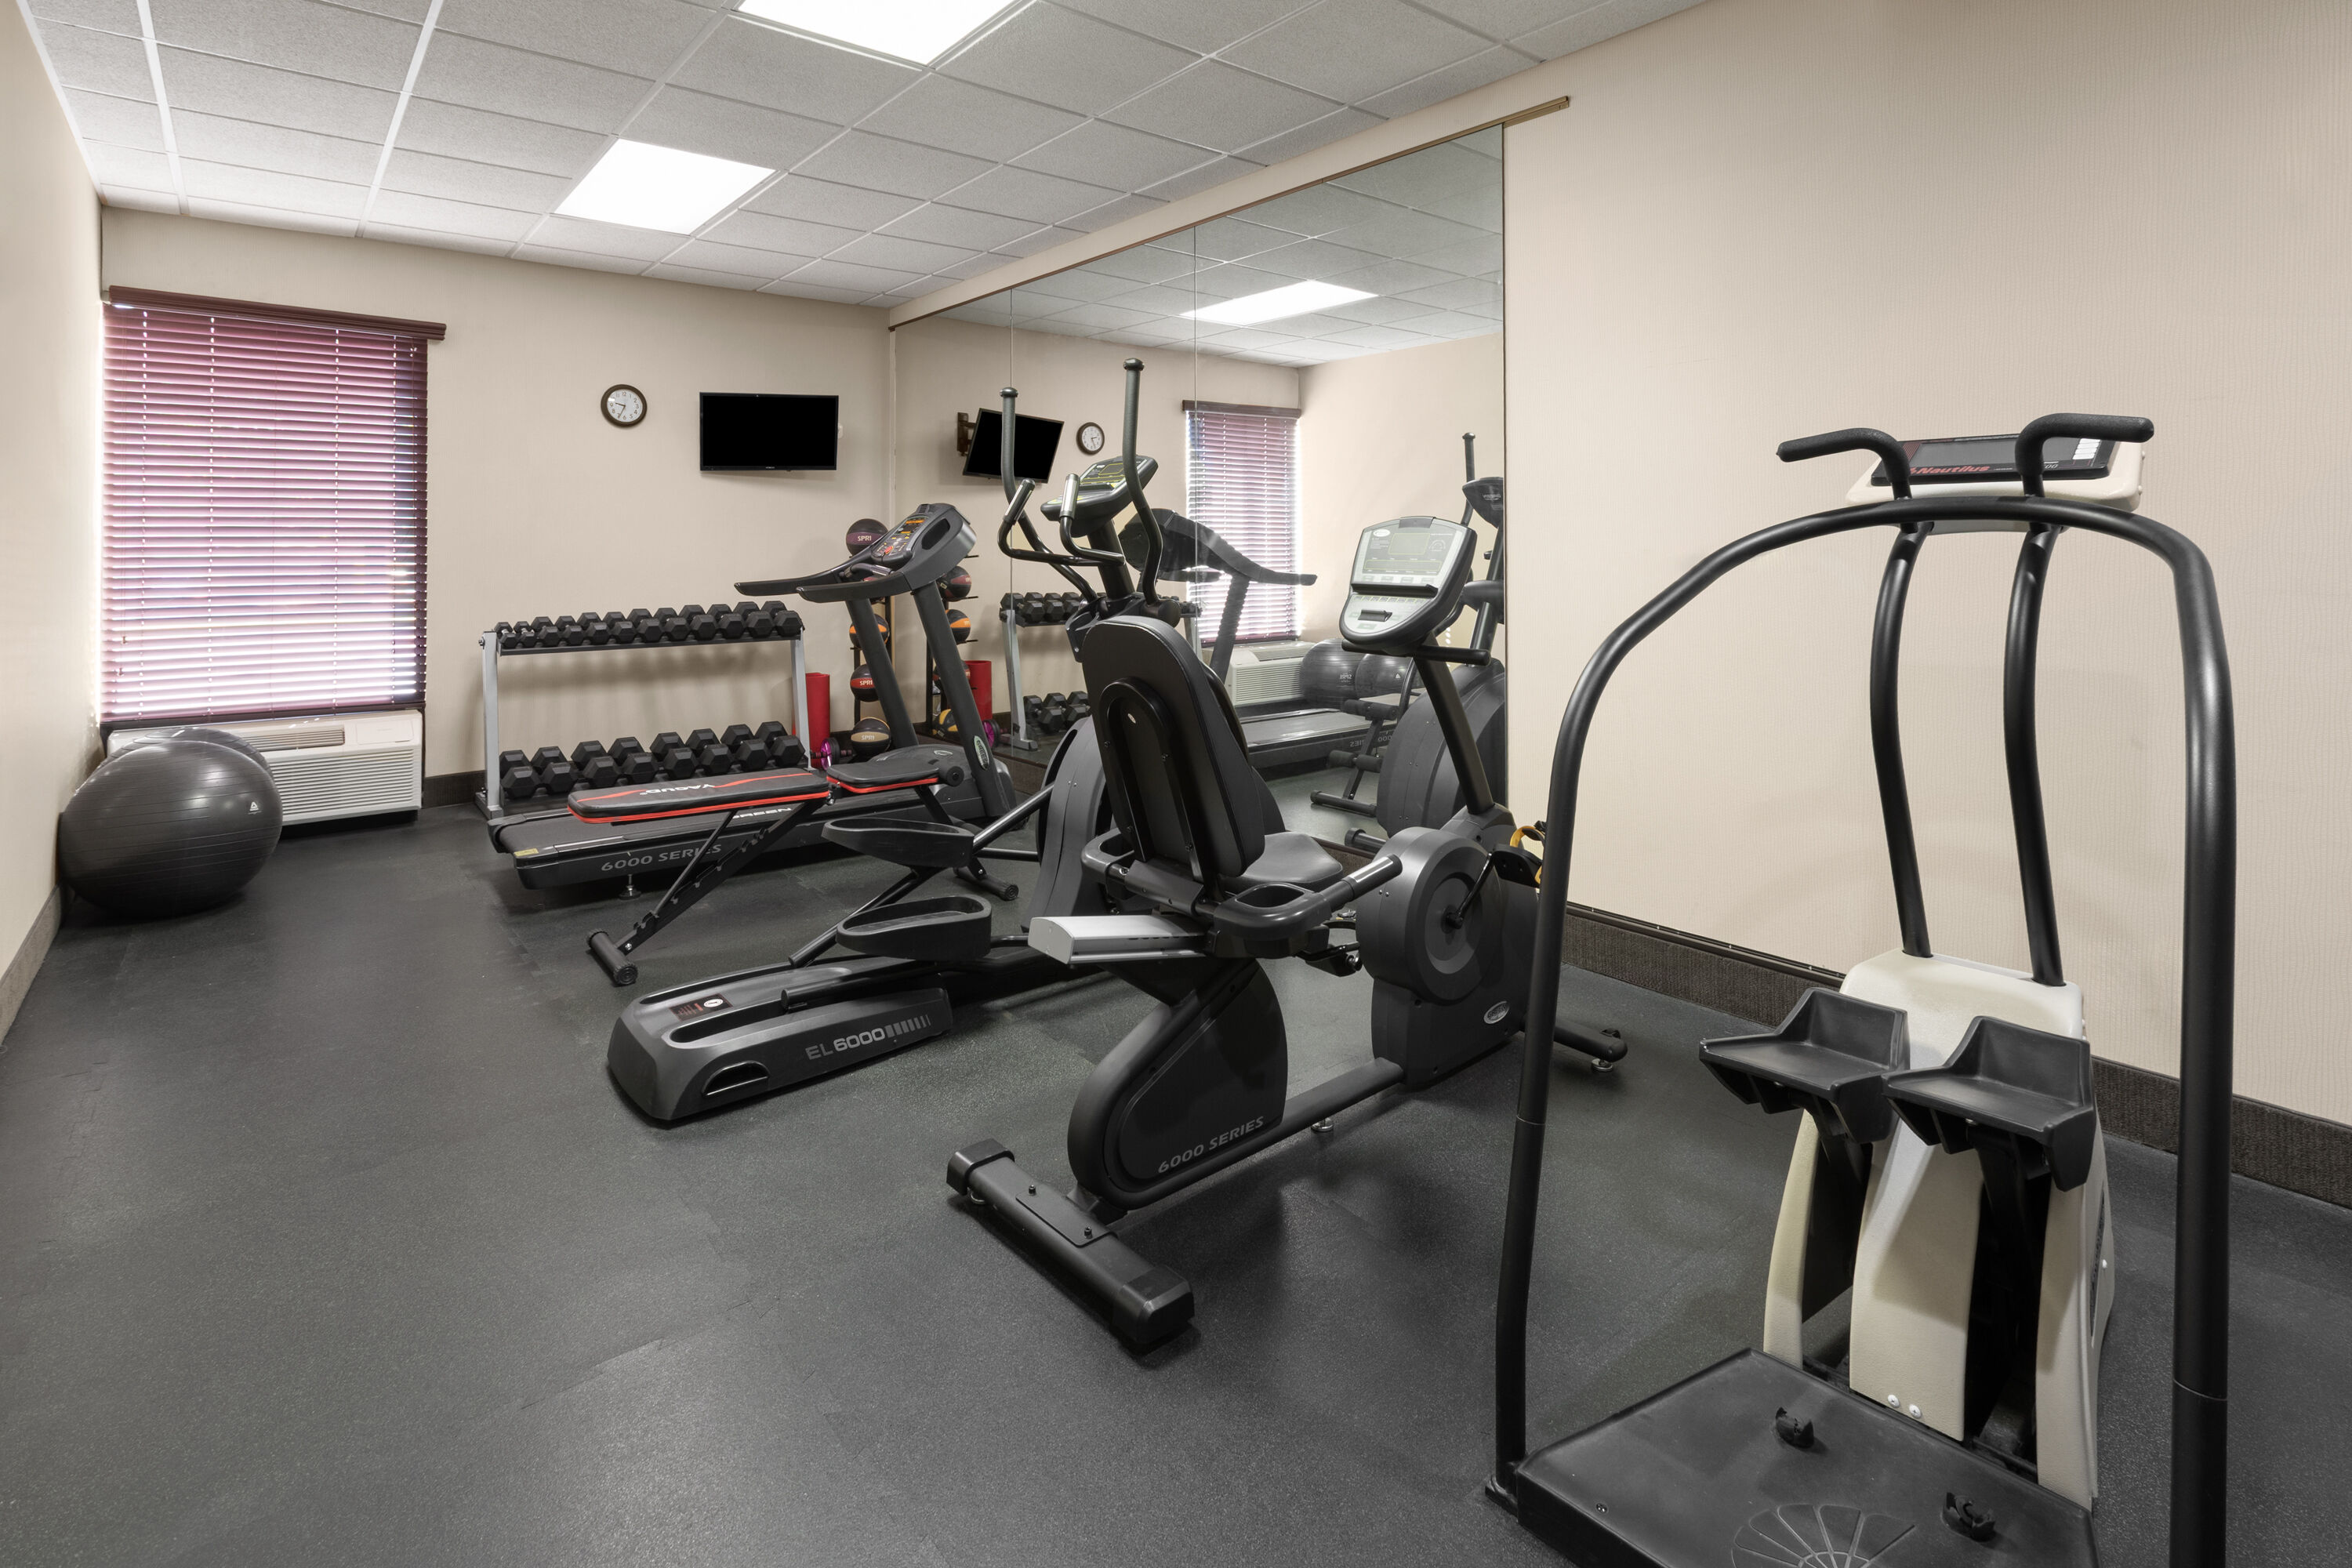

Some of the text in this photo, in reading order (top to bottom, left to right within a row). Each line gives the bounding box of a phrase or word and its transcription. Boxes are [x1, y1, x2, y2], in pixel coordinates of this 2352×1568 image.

[1916, 466, 1990, 474] Nautilus
[601, 844, 722, 871] 6000 SERIS
[1158, 1116, 1264, 1174] 6000 SERIES
